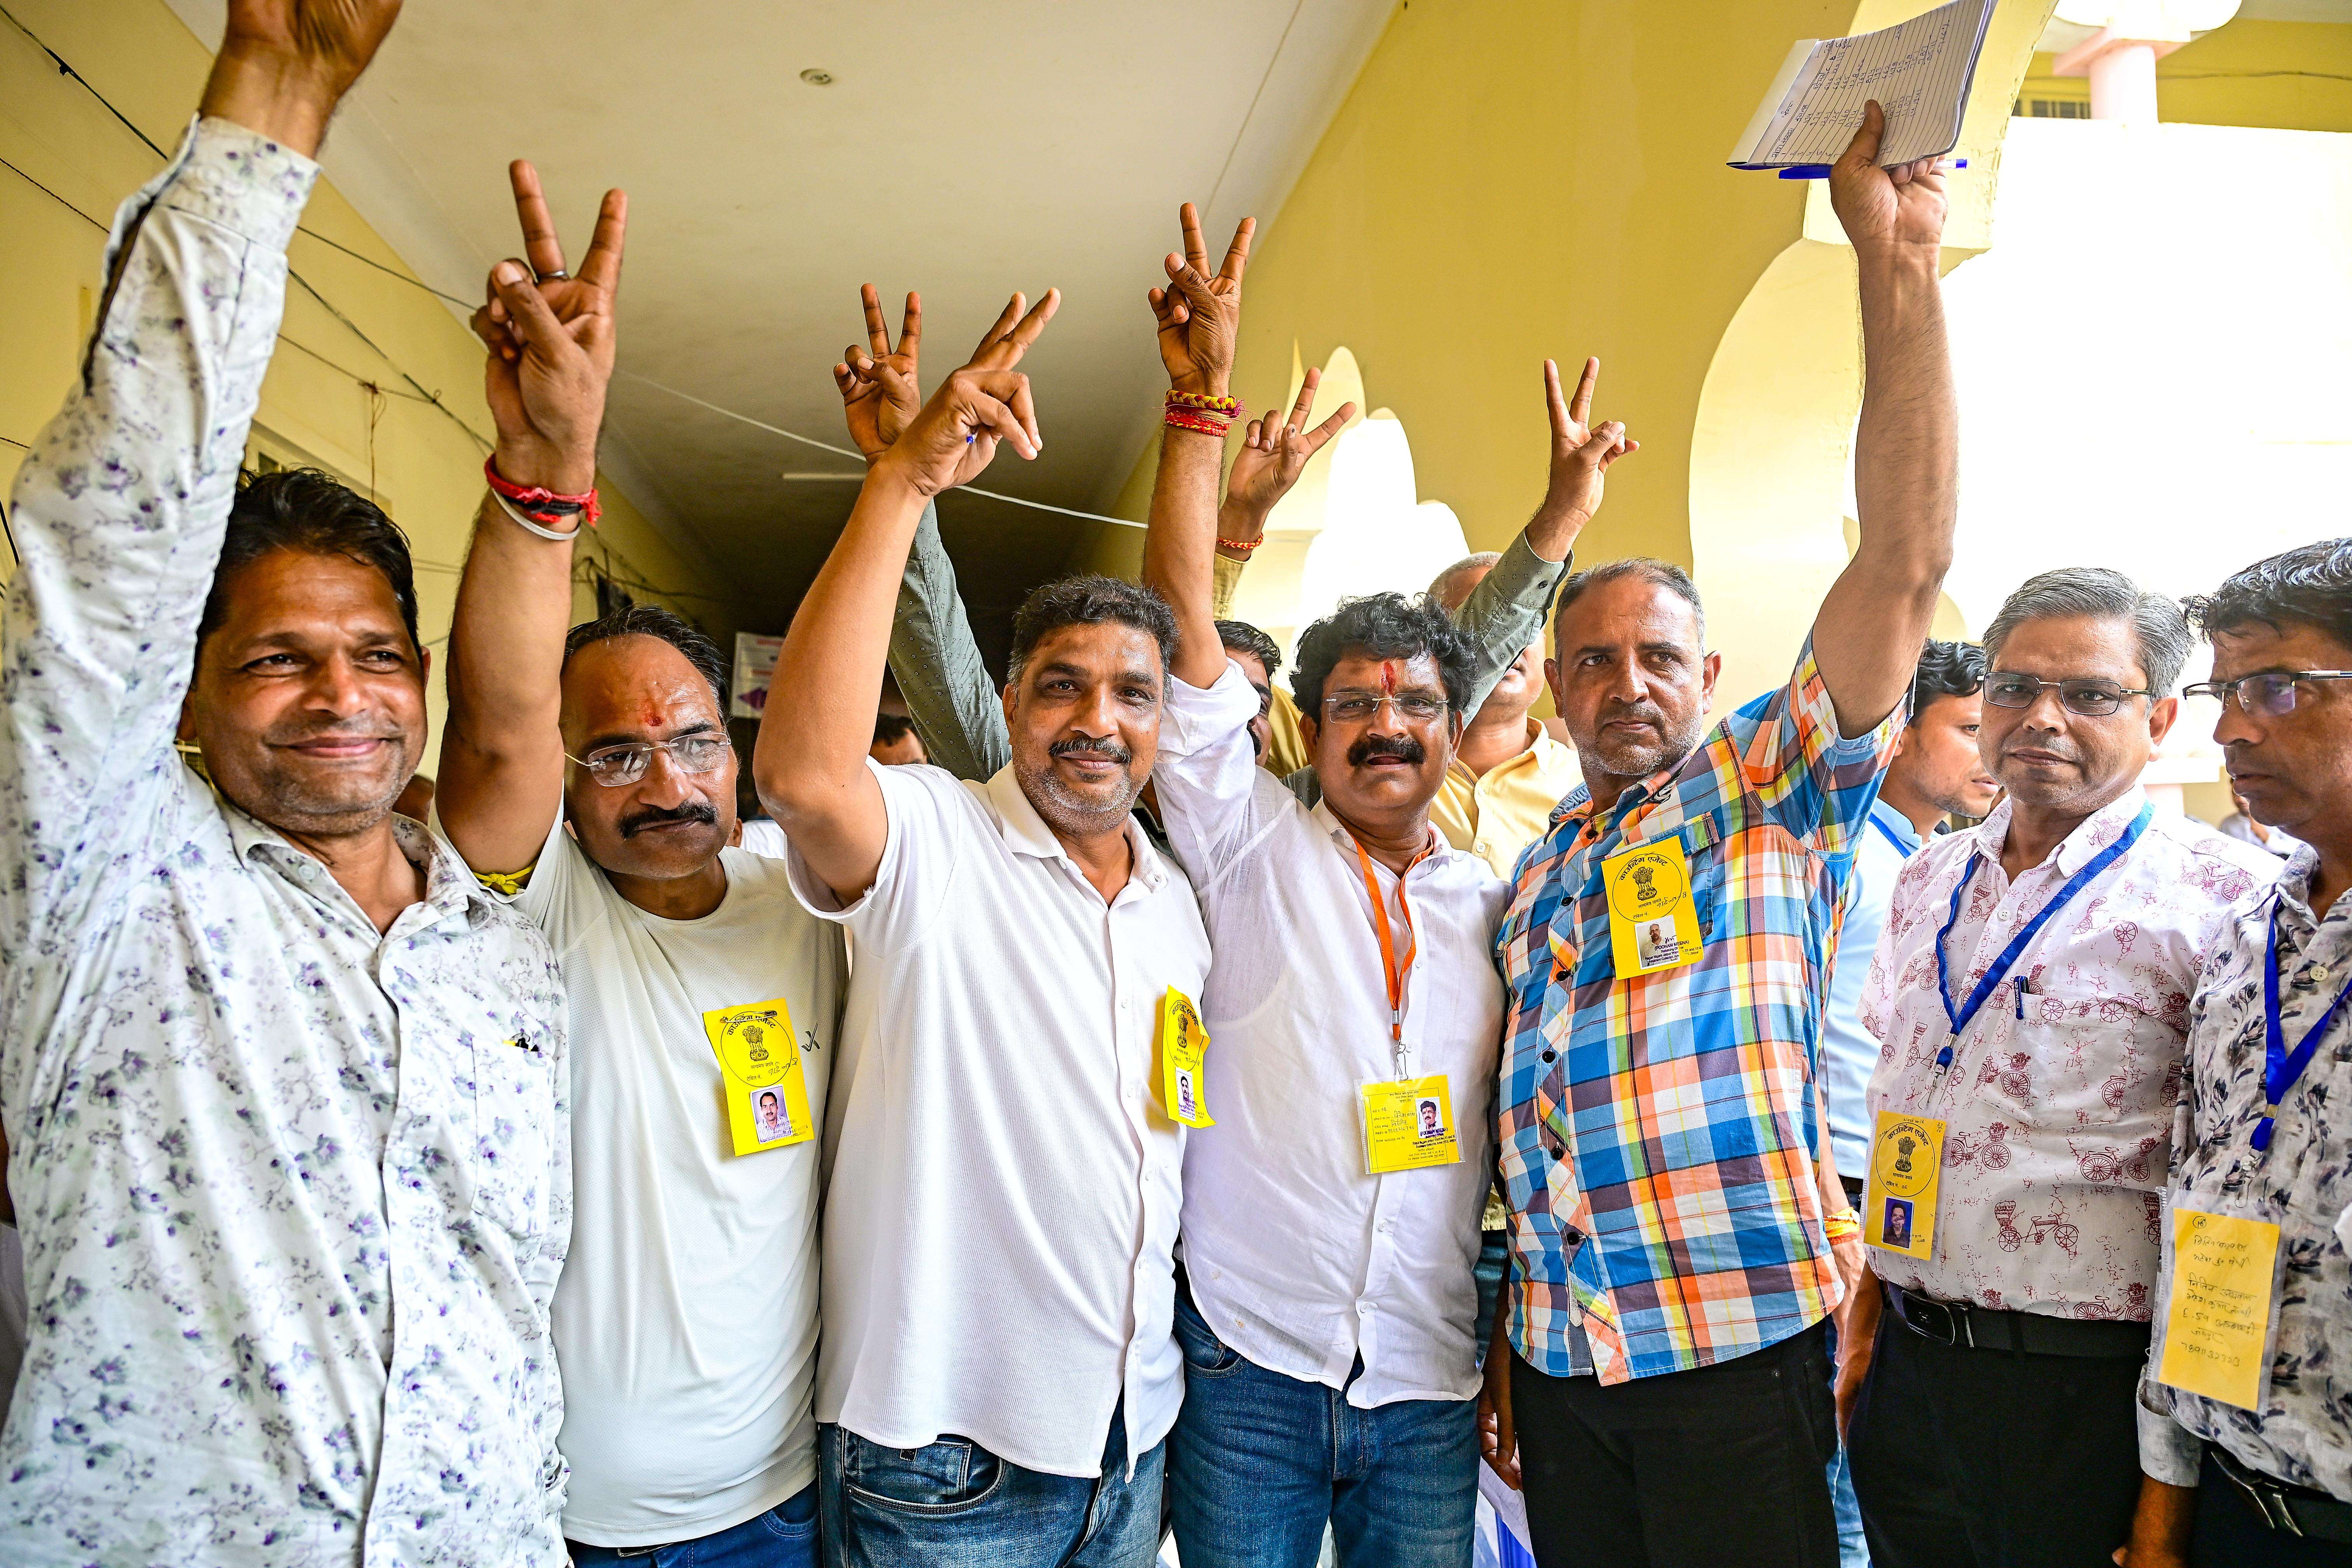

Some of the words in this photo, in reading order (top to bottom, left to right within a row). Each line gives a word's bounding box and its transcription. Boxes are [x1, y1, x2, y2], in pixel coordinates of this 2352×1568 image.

[1619, 856, 1645, 880] काउन्टिंग
[1647, 856, 1668, 866] एजेन्ट
[1887, 1124, 1913, 1140] काउन्टिंग
[1914, 1128, 1929, 1146] एजेन्ट
